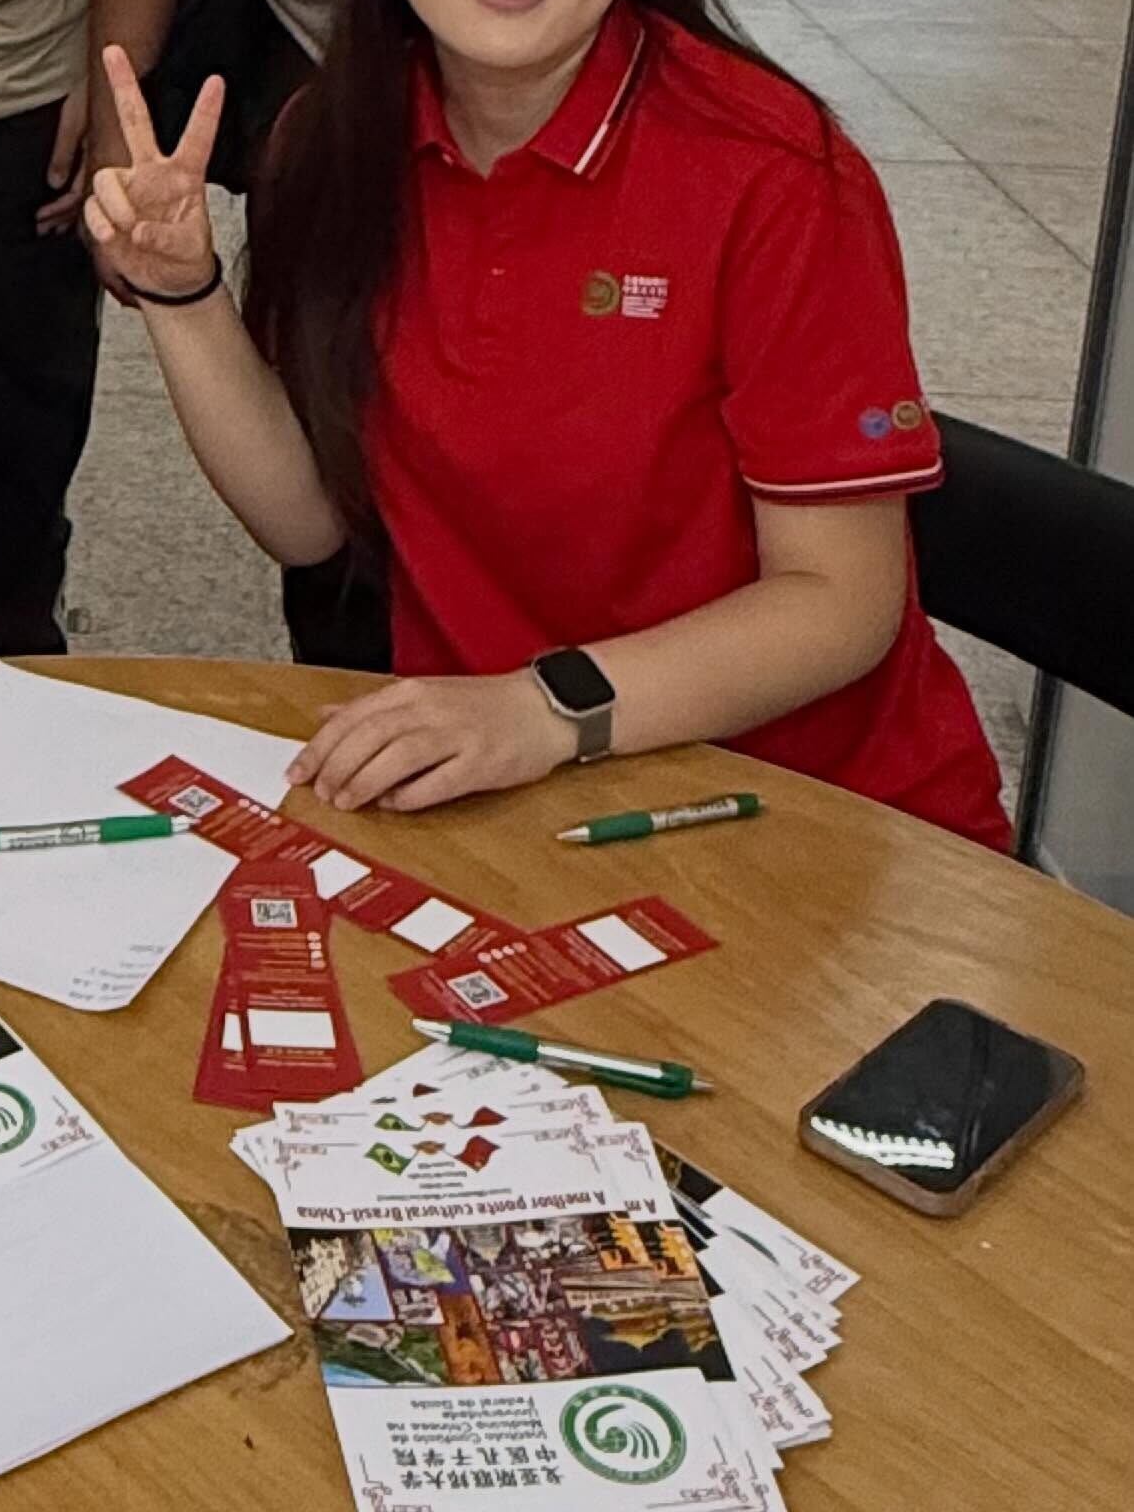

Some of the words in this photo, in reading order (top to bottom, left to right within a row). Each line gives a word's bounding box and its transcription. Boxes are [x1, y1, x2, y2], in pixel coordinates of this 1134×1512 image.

[477, 1194, 528, 1216] ponte
[531, 1191, 593, 1211] melhor
[592, 1190, 606, 1206] A
[404, 1202, 474, 1222] cultural
